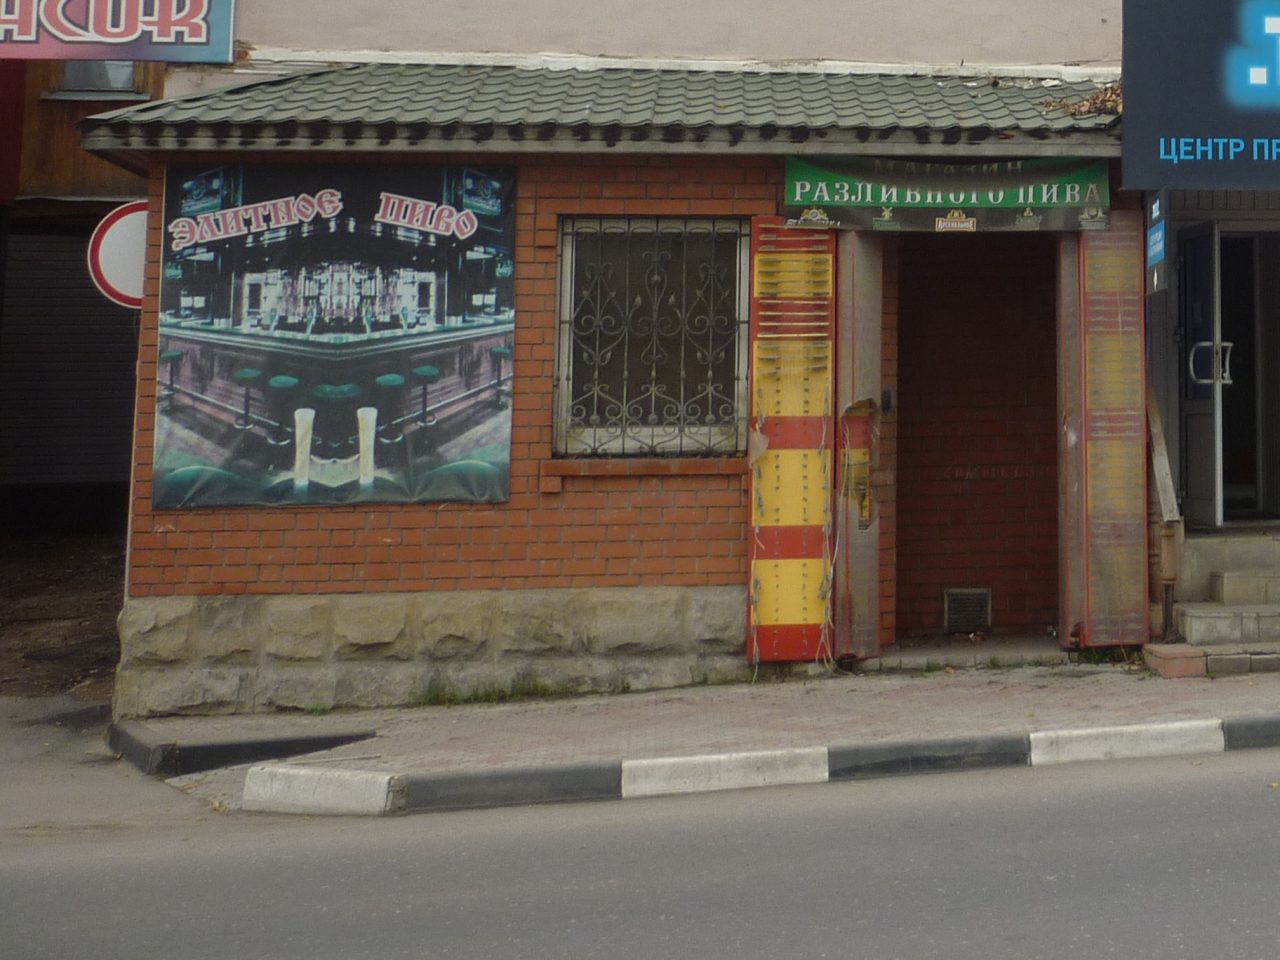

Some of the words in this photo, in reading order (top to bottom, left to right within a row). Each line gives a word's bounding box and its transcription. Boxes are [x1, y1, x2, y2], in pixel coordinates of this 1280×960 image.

[1158, 137, 1245, 163] ЦЕНТР
[793, 180, 1005, 205] РАЗЛИВНОГО
[1017, 183, 1101, 204] ПИВА
[168, 188, 344, 251] ЭЛИТНОЕ
[374, 191, 478, 240] ПИВО
